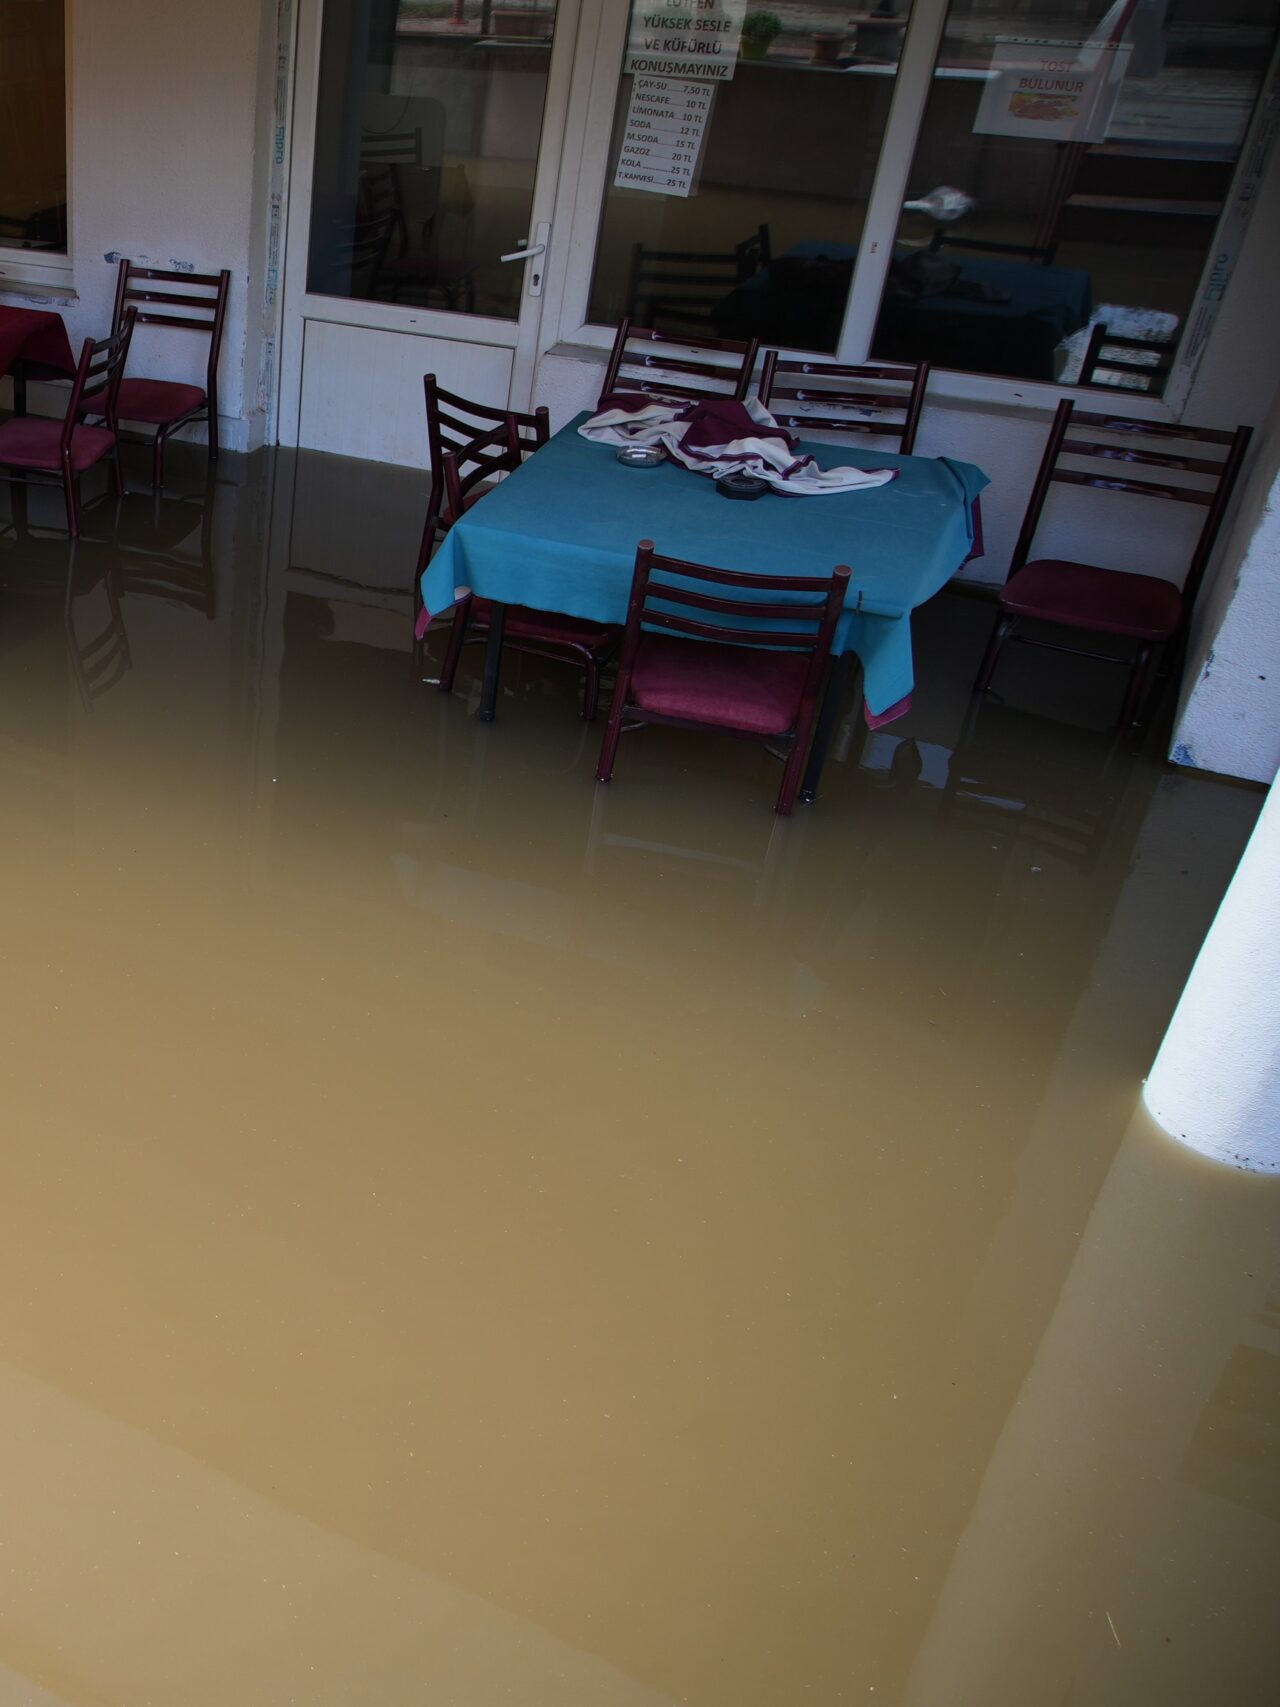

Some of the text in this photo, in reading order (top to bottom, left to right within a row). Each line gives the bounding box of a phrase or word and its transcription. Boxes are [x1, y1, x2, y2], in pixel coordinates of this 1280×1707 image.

[644, 14, 732, 32] YÜKSEK SESLE
[644, 38, 722, 54] VE KÜFÜRLÜ
[630, 59, 728, 77] KONUŞMAYINIZ
[1040, 60, 1074, 72] TOST
[702, 88, 710, 96] TL
[1019, 78, 1084, 92] BULUNUR
[635, 93, 706, 109] NESCAFE 10 TL
[632, 105, 675, 119] LİMONATA
[683, 113, 693, 122] 10
[629, 119, 699, 136] SODA 12 TL
[675, 140, 685, 148] 15
[687, 141, 695, 149] TL
[623, 145, 691, 162] GAZOZ 20 TL
[620, 158, 690, 176] KOLA 25 TL
[666, 178, 676, 187] 25
[678, 180, 686, 188] TL
